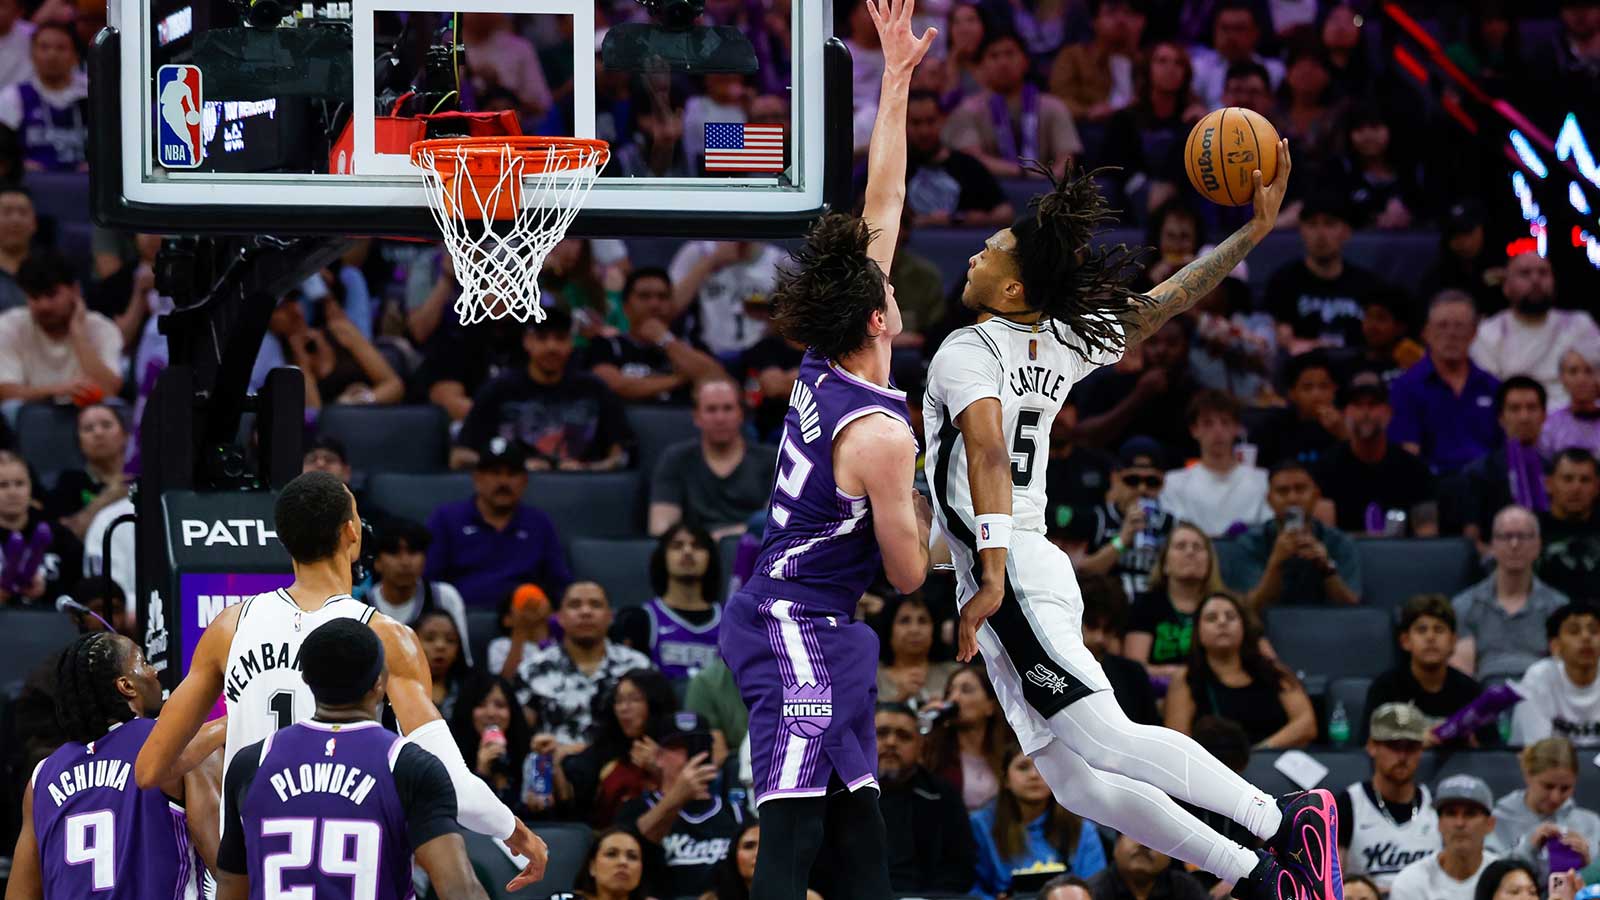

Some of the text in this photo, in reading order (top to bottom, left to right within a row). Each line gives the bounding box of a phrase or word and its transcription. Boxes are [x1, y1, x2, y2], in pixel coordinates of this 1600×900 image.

[164, 144, 186, 161] NBA
[1198, 127, 1220, 192] Wilson
[1010, 365, 1065, 402] CASTLE
[1010, 406, 1044, 490] 5
[771, 422, 815, 529] 2
[783, 704, 833, 717] KINGS
[47, 759, 132, 807] ACHIUWA
[269, 762, 377, 806] PLOWDEN
[65, 808, 116, 892] 9
[261, 816, 382, 900] 29
[1362, 842, 1433, 875] Kin
